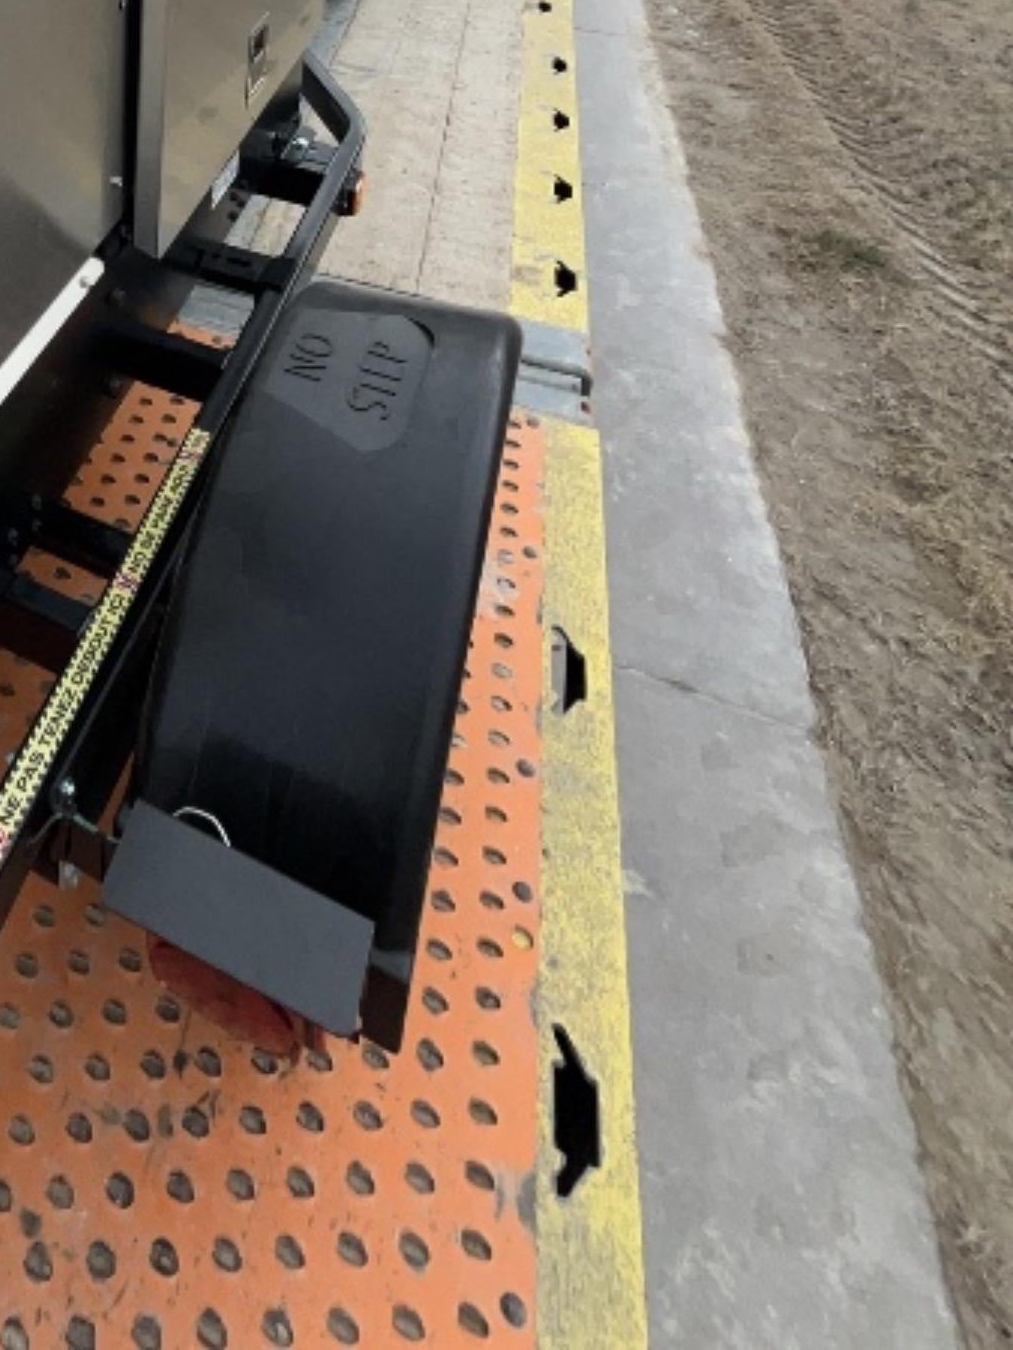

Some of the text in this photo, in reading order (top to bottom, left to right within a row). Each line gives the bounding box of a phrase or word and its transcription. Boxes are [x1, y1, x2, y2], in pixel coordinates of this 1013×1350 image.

[283, 332, 334, 382] NO
[346, 339, 408, 422] STEP
[16, 750, 45, 793] PAS
